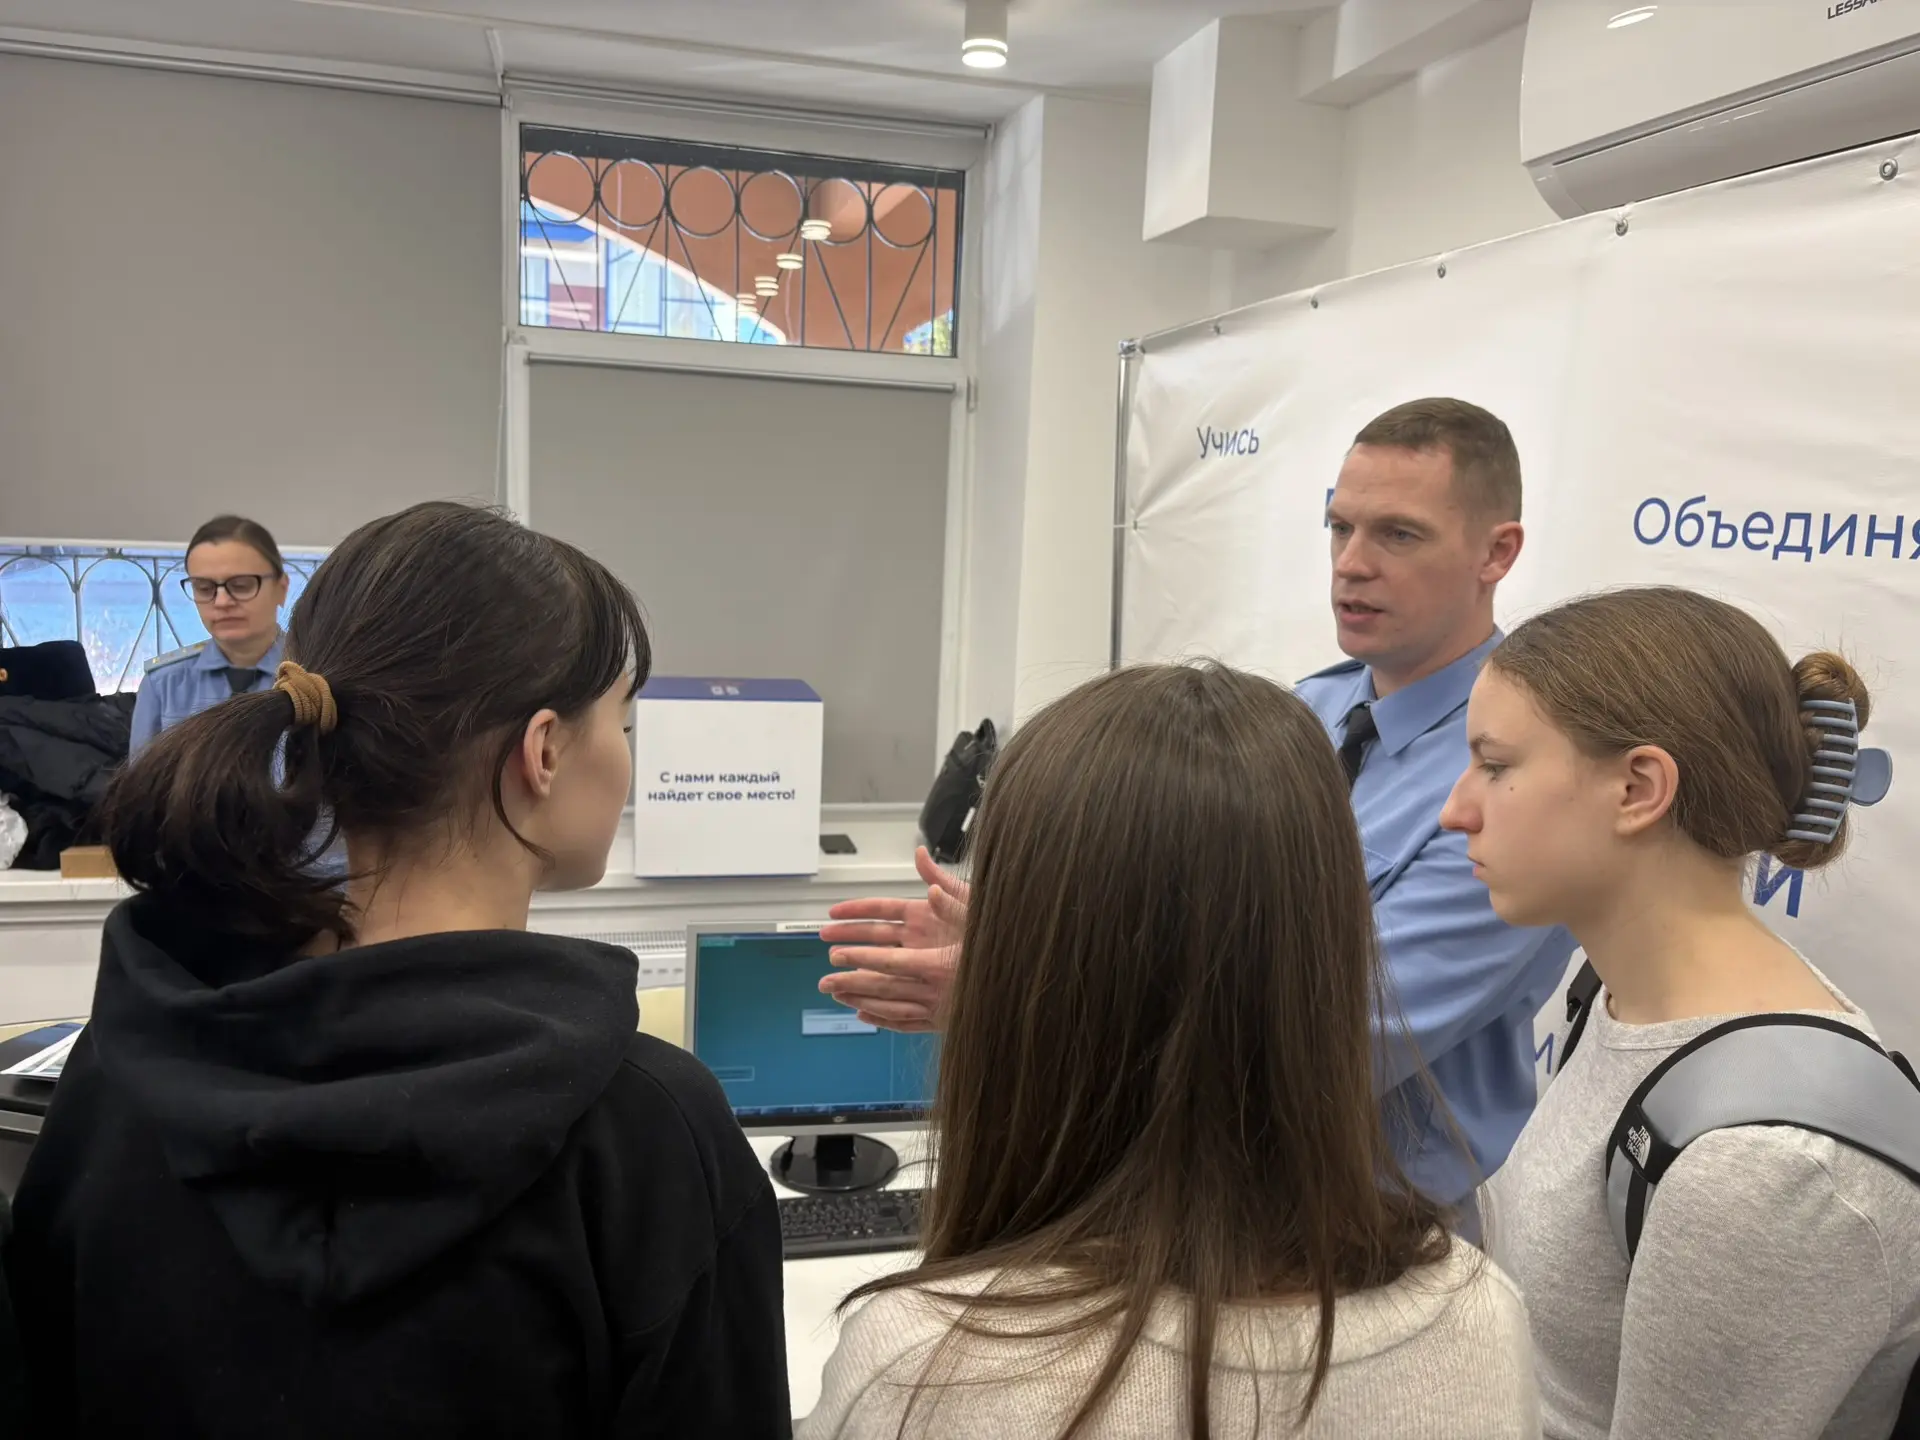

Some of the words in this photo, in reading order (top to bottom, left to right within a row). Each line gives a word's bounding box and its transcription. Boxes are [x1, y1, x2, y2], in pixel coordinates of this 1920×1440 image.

[1827, 0, 1881, 20] LESS
[1197, 426, 1260, 460] Учись
[660, 771, 671, 783] С
[675, 773, 714, 783] нами
[719, 770, 780, 784] каждый
[648, 788, 703, 802] найдет
[708, 791, 743, 801] свое
[747, 788, 796, 801] место!
[1627, 1126, 1643, 1149] NORTH
[1638, 1125, 1650, 1142] THE
